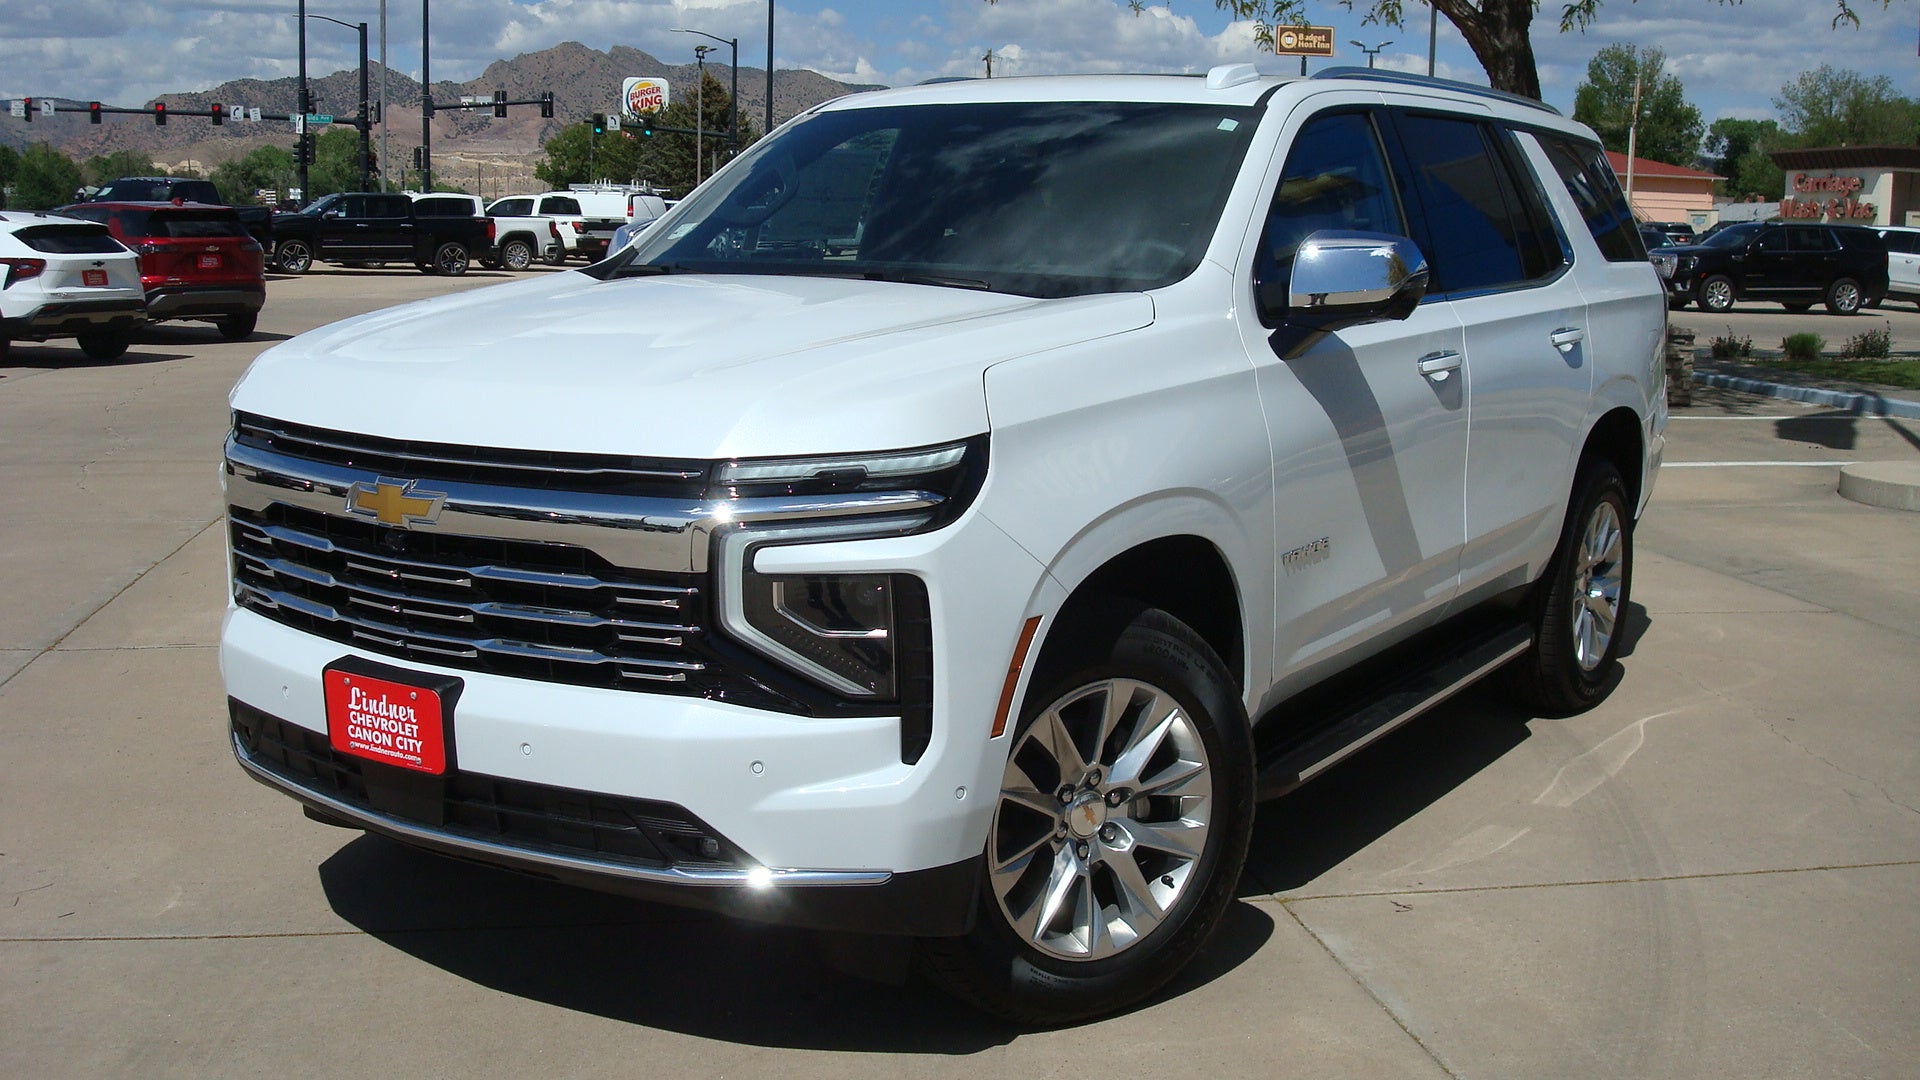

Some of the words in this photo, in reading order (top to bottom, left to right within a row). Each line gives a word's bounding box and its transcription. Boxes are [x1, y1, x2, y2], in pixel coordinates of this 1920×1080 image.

[1317, 41, 1331, 49] Inn
[630, 86, 662, 101] BURGER
[631, 94, 663, 112] KING
[1793, 172, 1861, 198] Carriage
[1779, 199, 1820, 219] Wash
[1826, 198, 1839, 218] &
[1842, 198, 1875, 218] Vac
[347, 686, 418, 723] Lindner
[349, 710, 419, 738] CHEVROLET
[347, 725, 393, 748] CANON
[395, 736, 423, 754] CITY
